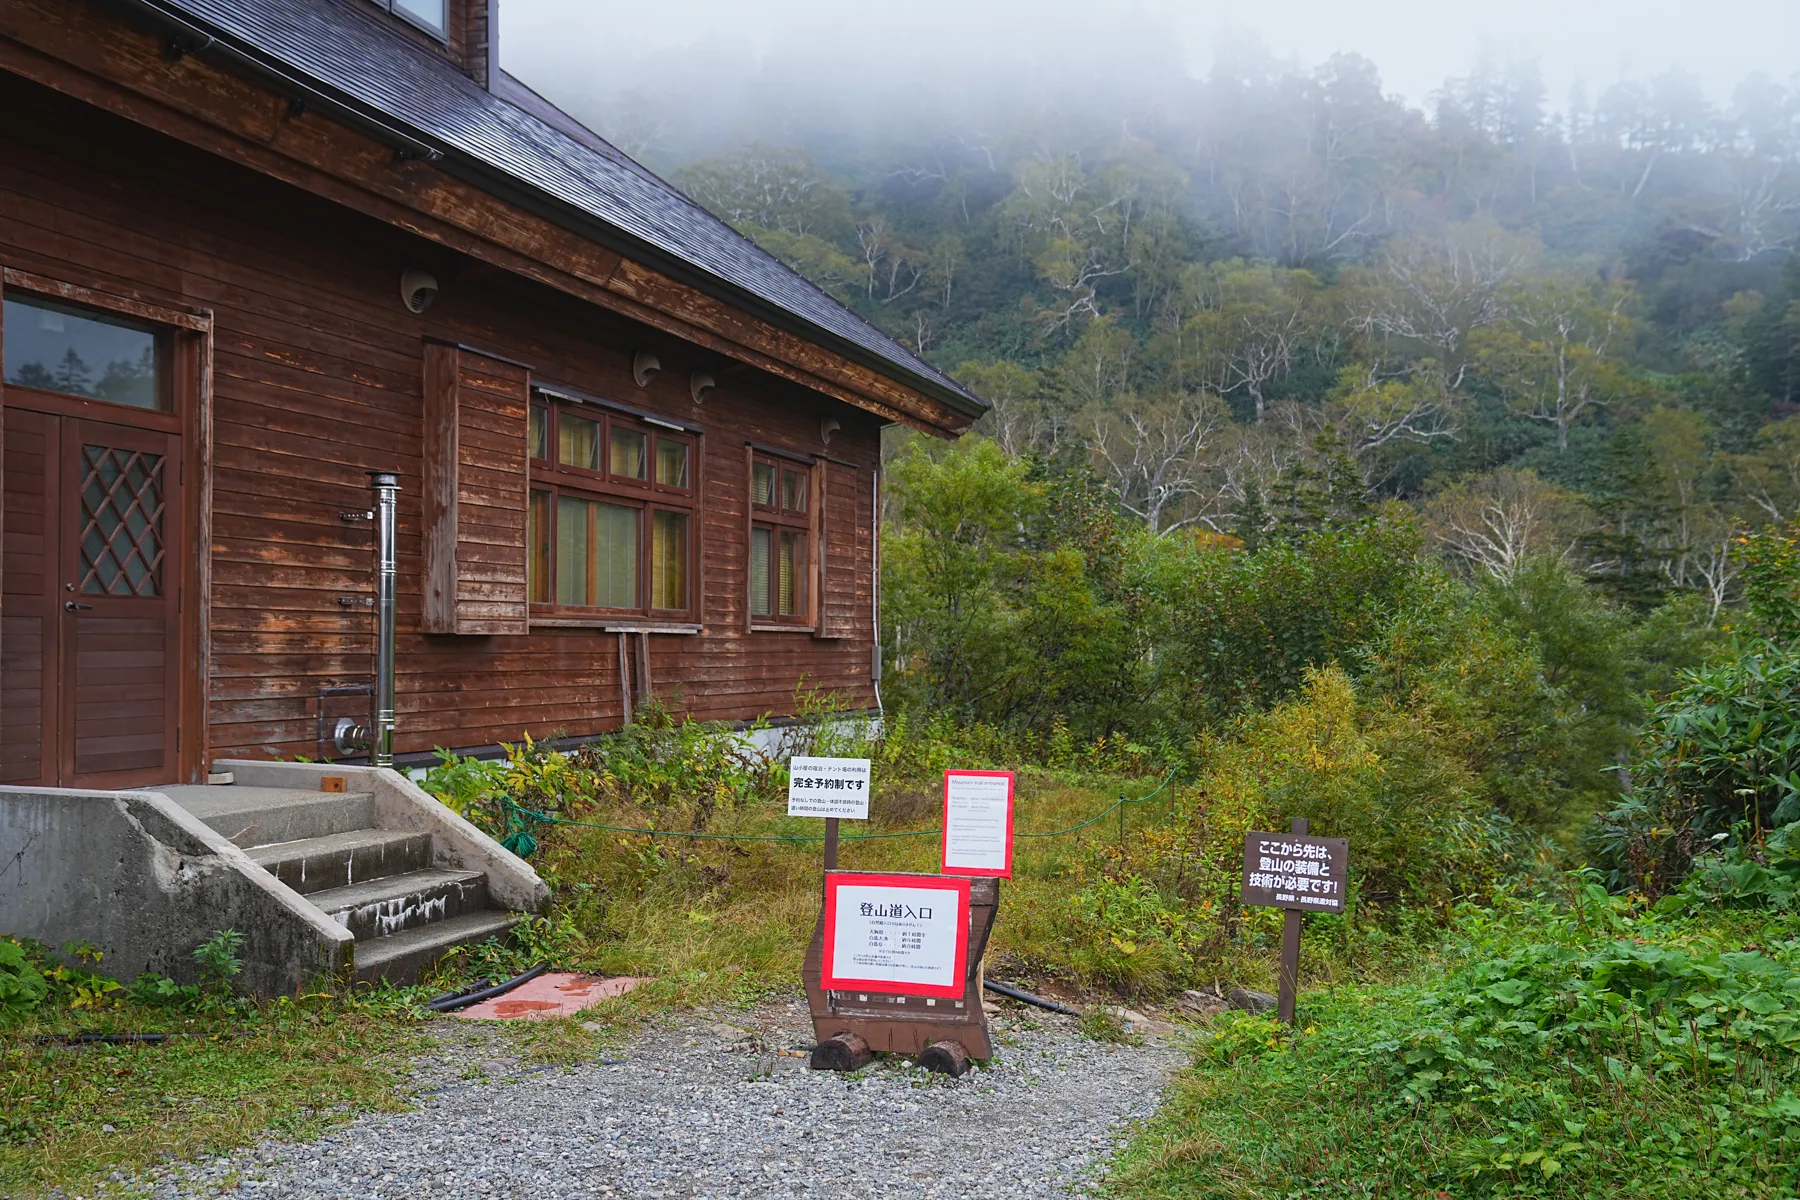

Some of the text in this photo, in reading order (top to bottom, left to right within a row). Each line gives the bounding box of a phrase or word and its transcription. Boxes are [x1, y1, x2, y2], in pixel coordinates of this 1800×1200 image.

[793, 777, 865, 790] 完全予約制です
[1259, 841, 1332, 860] ここから先は、
[1259, 857, 1330, 877] 登山の装備と
[860, 902, 932, 920] 登山道入口
